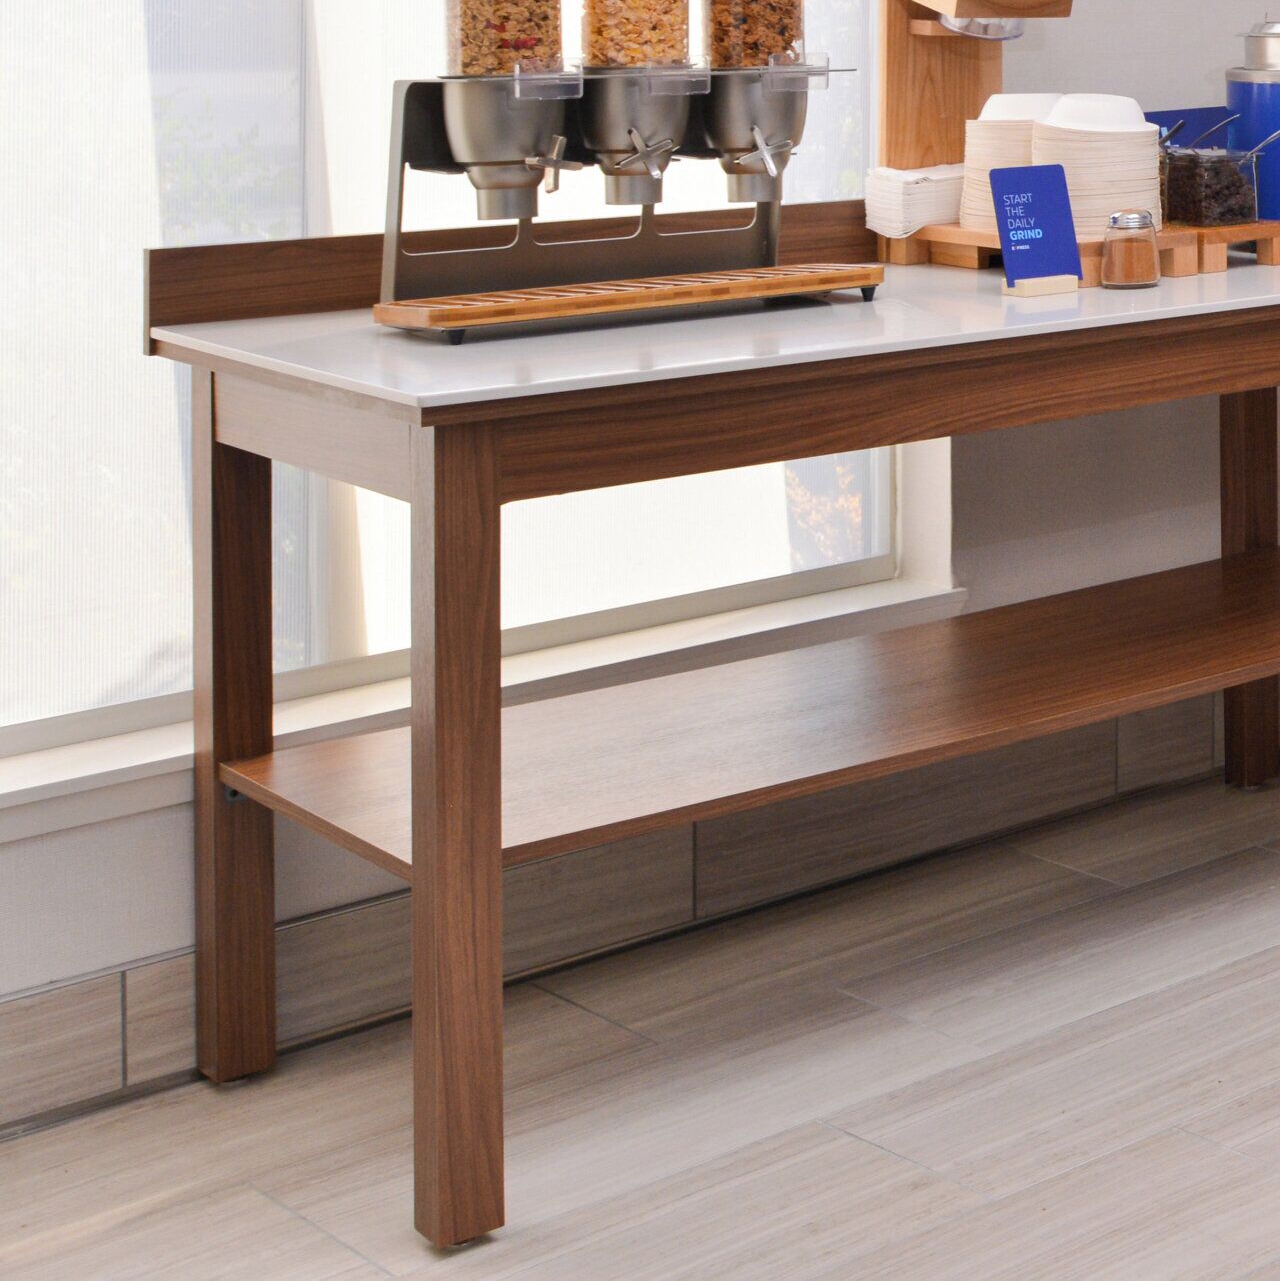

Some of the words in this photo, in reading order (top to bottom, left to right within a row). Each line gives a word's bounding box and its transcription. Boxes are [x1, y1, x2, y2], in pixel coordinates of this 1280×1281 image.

[1003, 193, 1032, 206] START
[1005, 206, 1025, 217] THE
[1008, 218, 1035, 229] DAILY
[1010, 229, 1043, 240] GRIND
